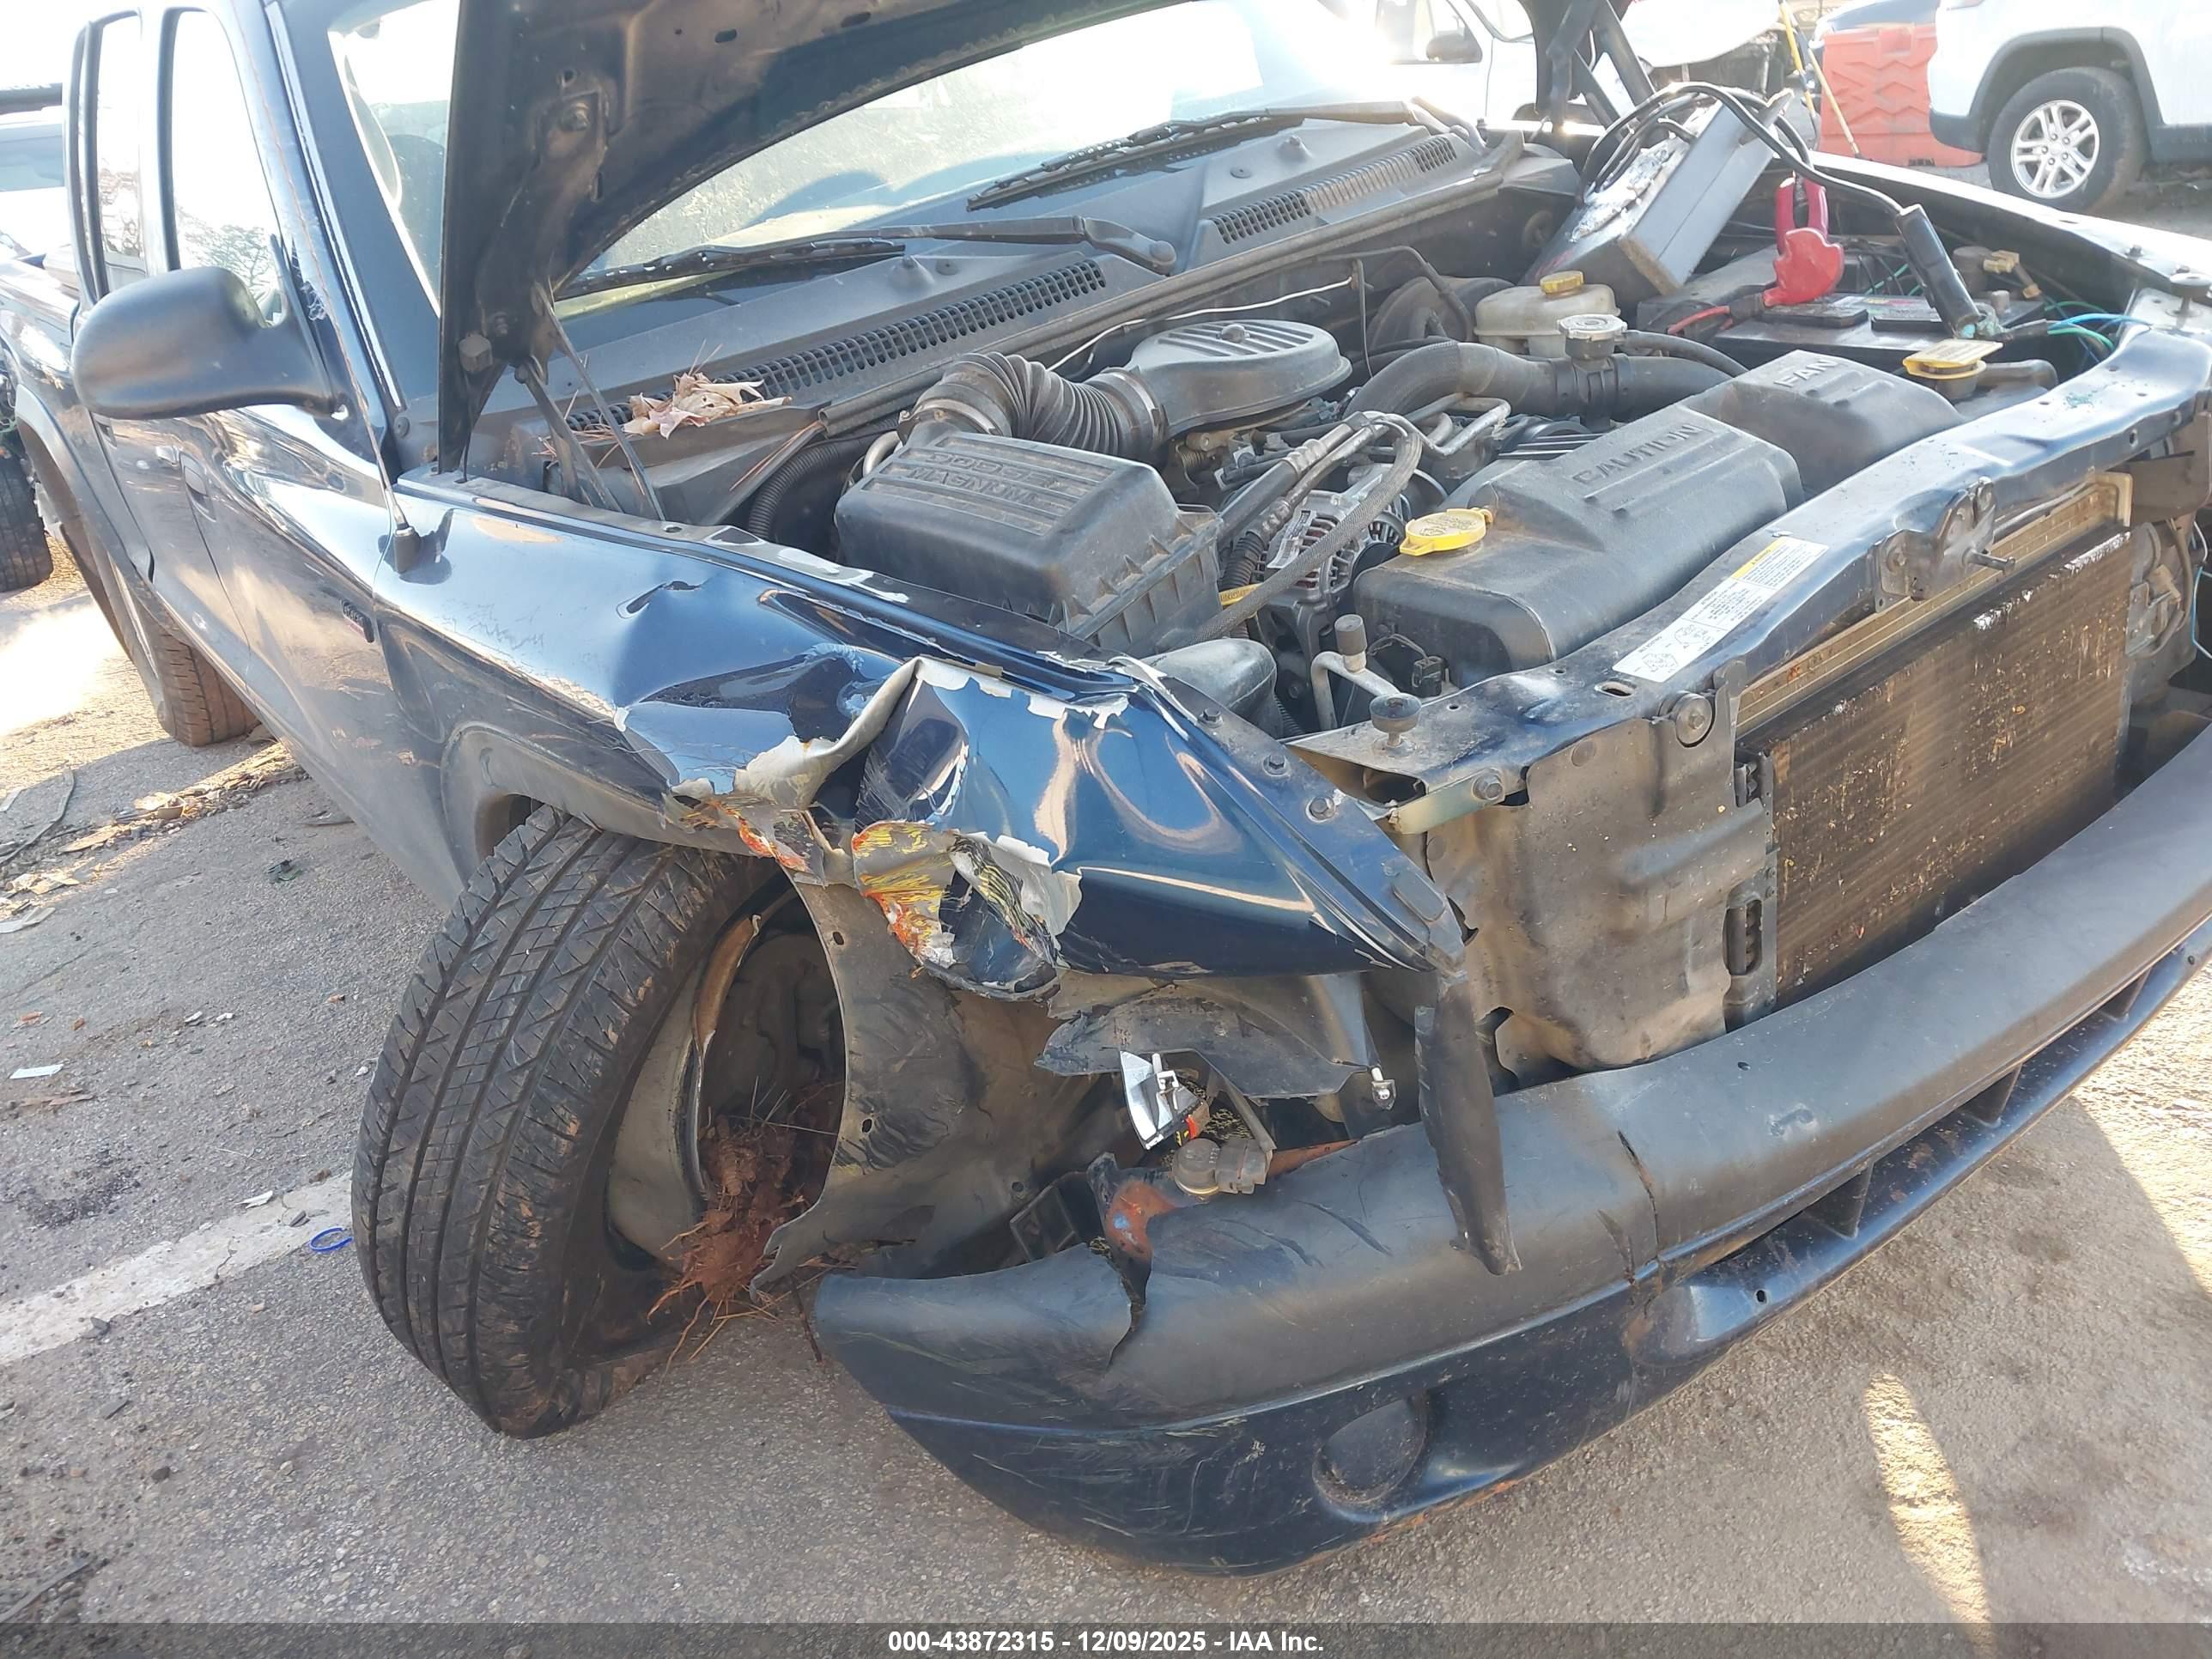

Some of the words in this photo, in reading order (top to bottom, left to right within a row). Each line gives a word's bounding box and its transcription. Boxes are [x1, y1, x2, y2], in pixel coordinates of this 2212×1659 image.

[1772, 359, 1839, 388] FAN
[926, 451, 1054, 489] DODGE
[1572, 423, 1714, 485] CAUTION
[908, 465, 1038, 505] MAGNUM
